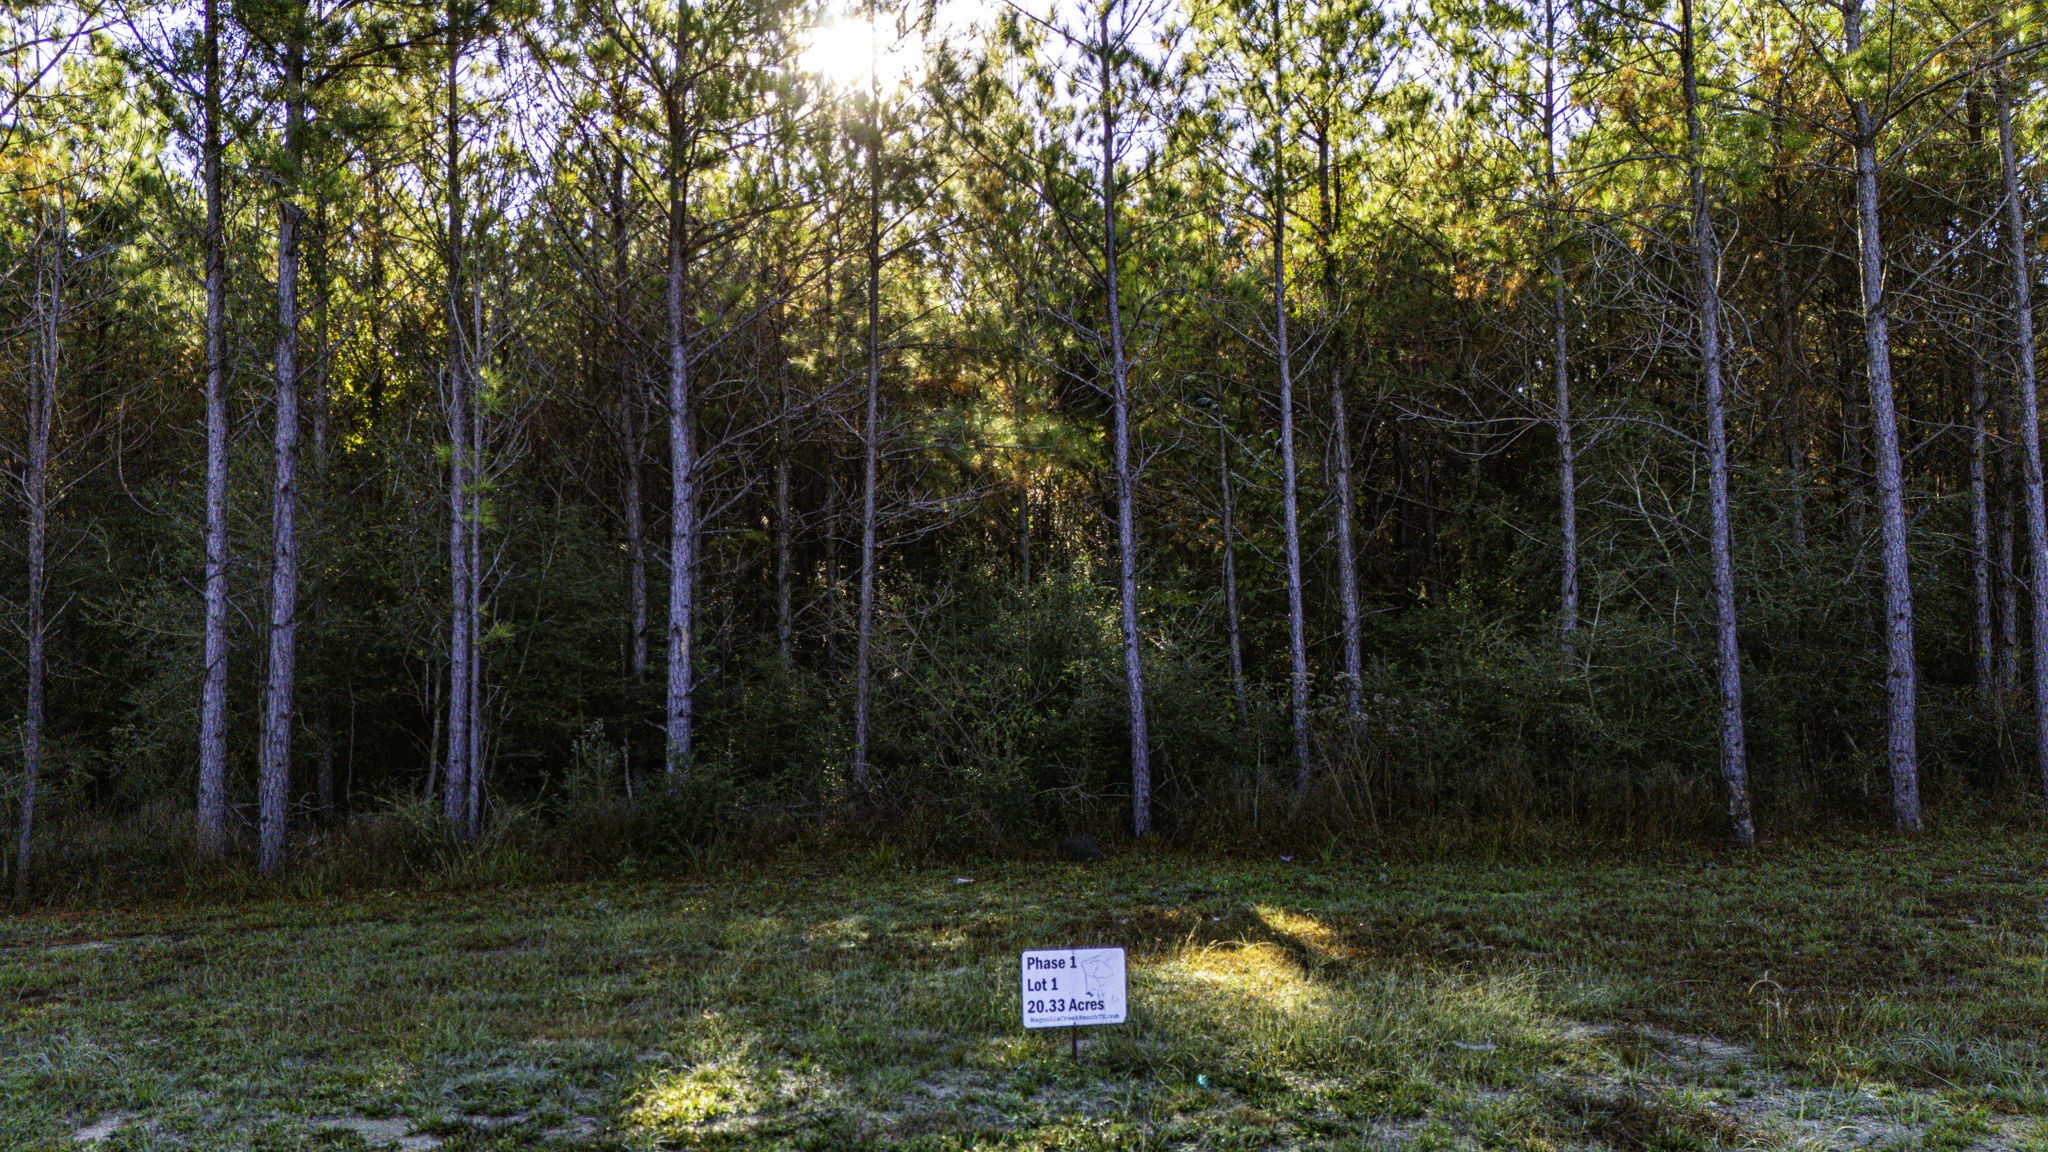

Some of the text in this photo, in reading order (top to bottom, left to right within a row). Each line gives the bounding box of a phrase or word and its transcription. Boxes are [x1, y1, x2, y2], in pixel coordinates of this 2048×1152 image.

[1027, 956, 1077, 970] Phase 1
[1027, 978, 1058, 991] Lot 1
[1027, 998, 1105, 1013] 20.33 Acres
